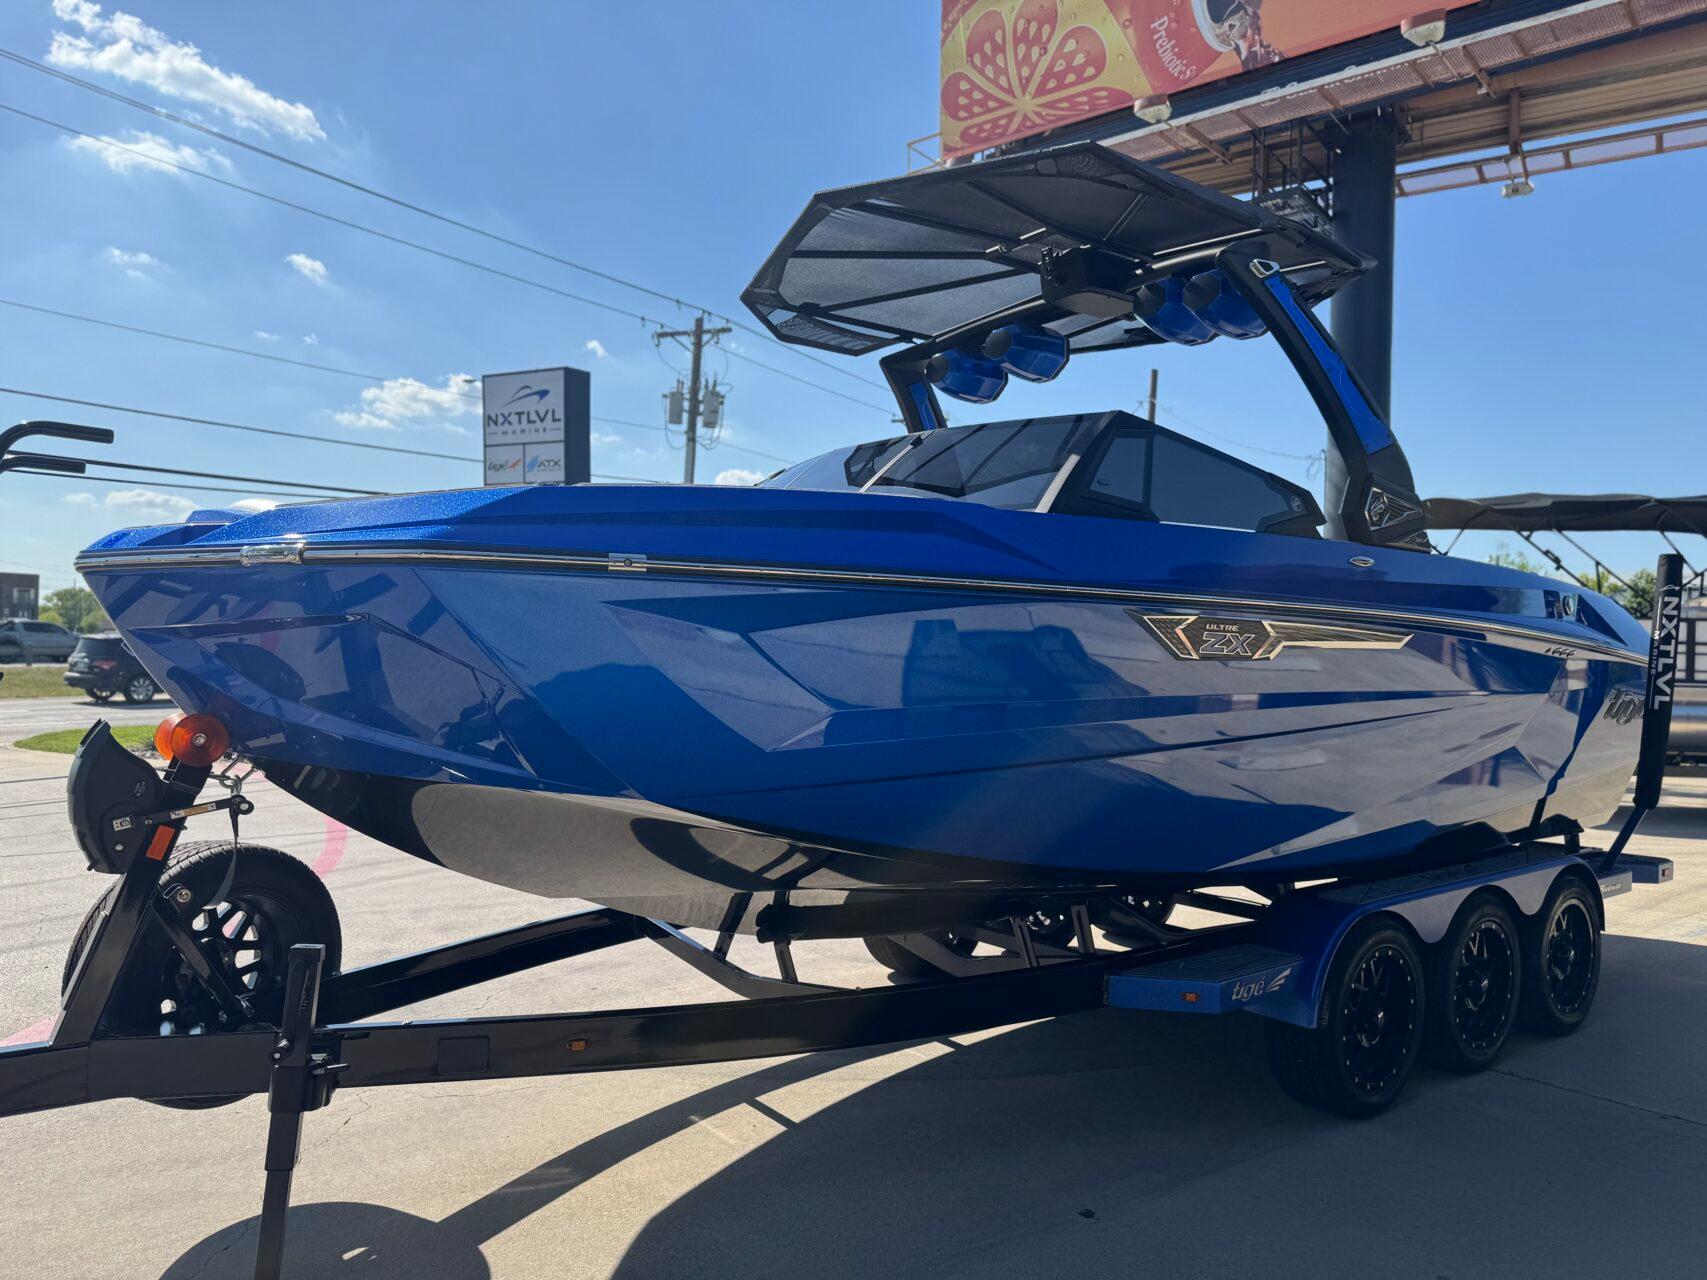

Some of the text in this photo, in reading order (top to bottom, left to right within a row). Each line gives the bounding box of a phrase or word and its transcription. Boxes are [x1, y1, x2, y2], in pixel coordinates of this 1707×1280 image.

[1150, 15, 1186, 77] Prebiotic
[487, 408, 562, 427] NXTLVL
[537, 459, 562, 468] ATX
[1200, 631, 1256, 656] ZX
[1650, 630, 1660, 675] MARINE
[1653, 596, 1680, 710] NXTLVL
[1231, 975, 1266, 1002] tigé
